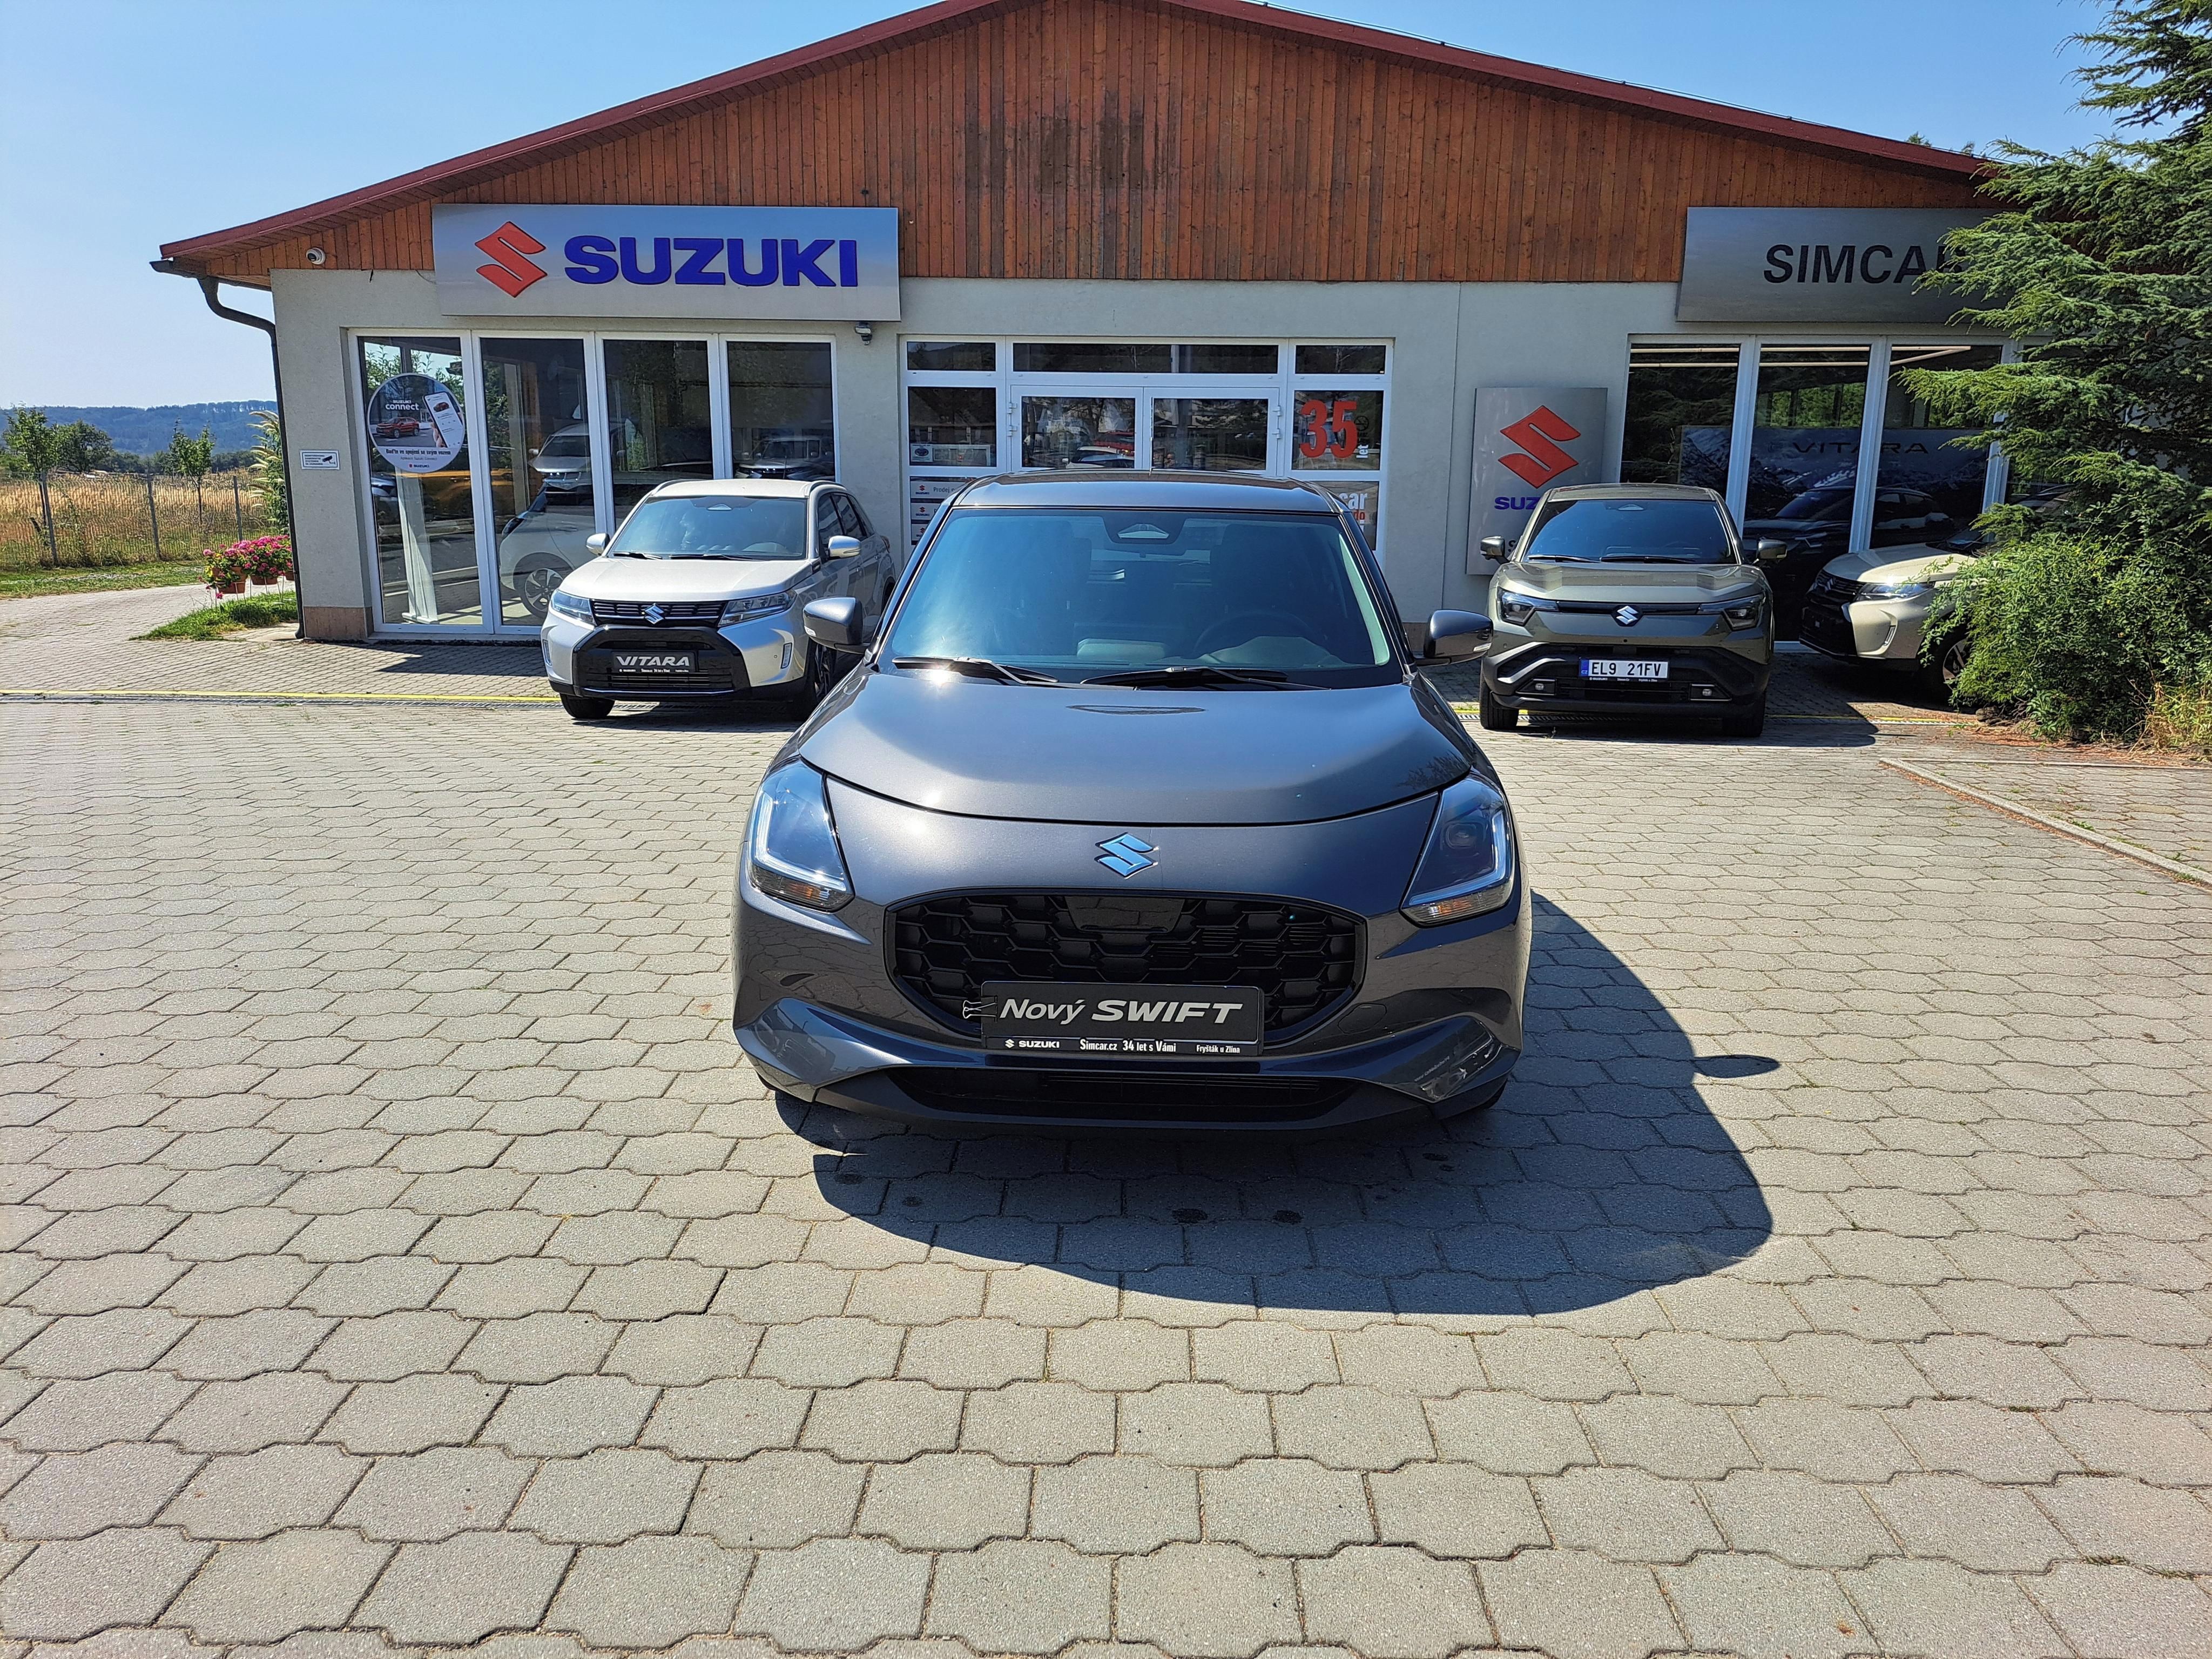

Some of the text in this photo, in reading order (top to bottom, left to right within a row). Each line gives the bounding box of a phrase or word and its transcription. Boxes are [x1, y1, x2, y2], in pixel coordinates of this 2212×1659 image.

[564, 235, 858, 287] SUZUKI
[1299, 399, 1368, 458] 35 let
[1792, 442, 1928, 454] VITRA
[1494, 496, 1541, 510] SUZ
[616, 656, 690, 666] VITARA
[1591, 662, 1661, 676] EL9 21FV
[1000, 999, 1243, 1025] Nový SWIFT
[1080, 1038, 1176, 1052] Simcar.cz 34 let s Vámi
[1196, 1044, 1218, 1054] Fryšták
